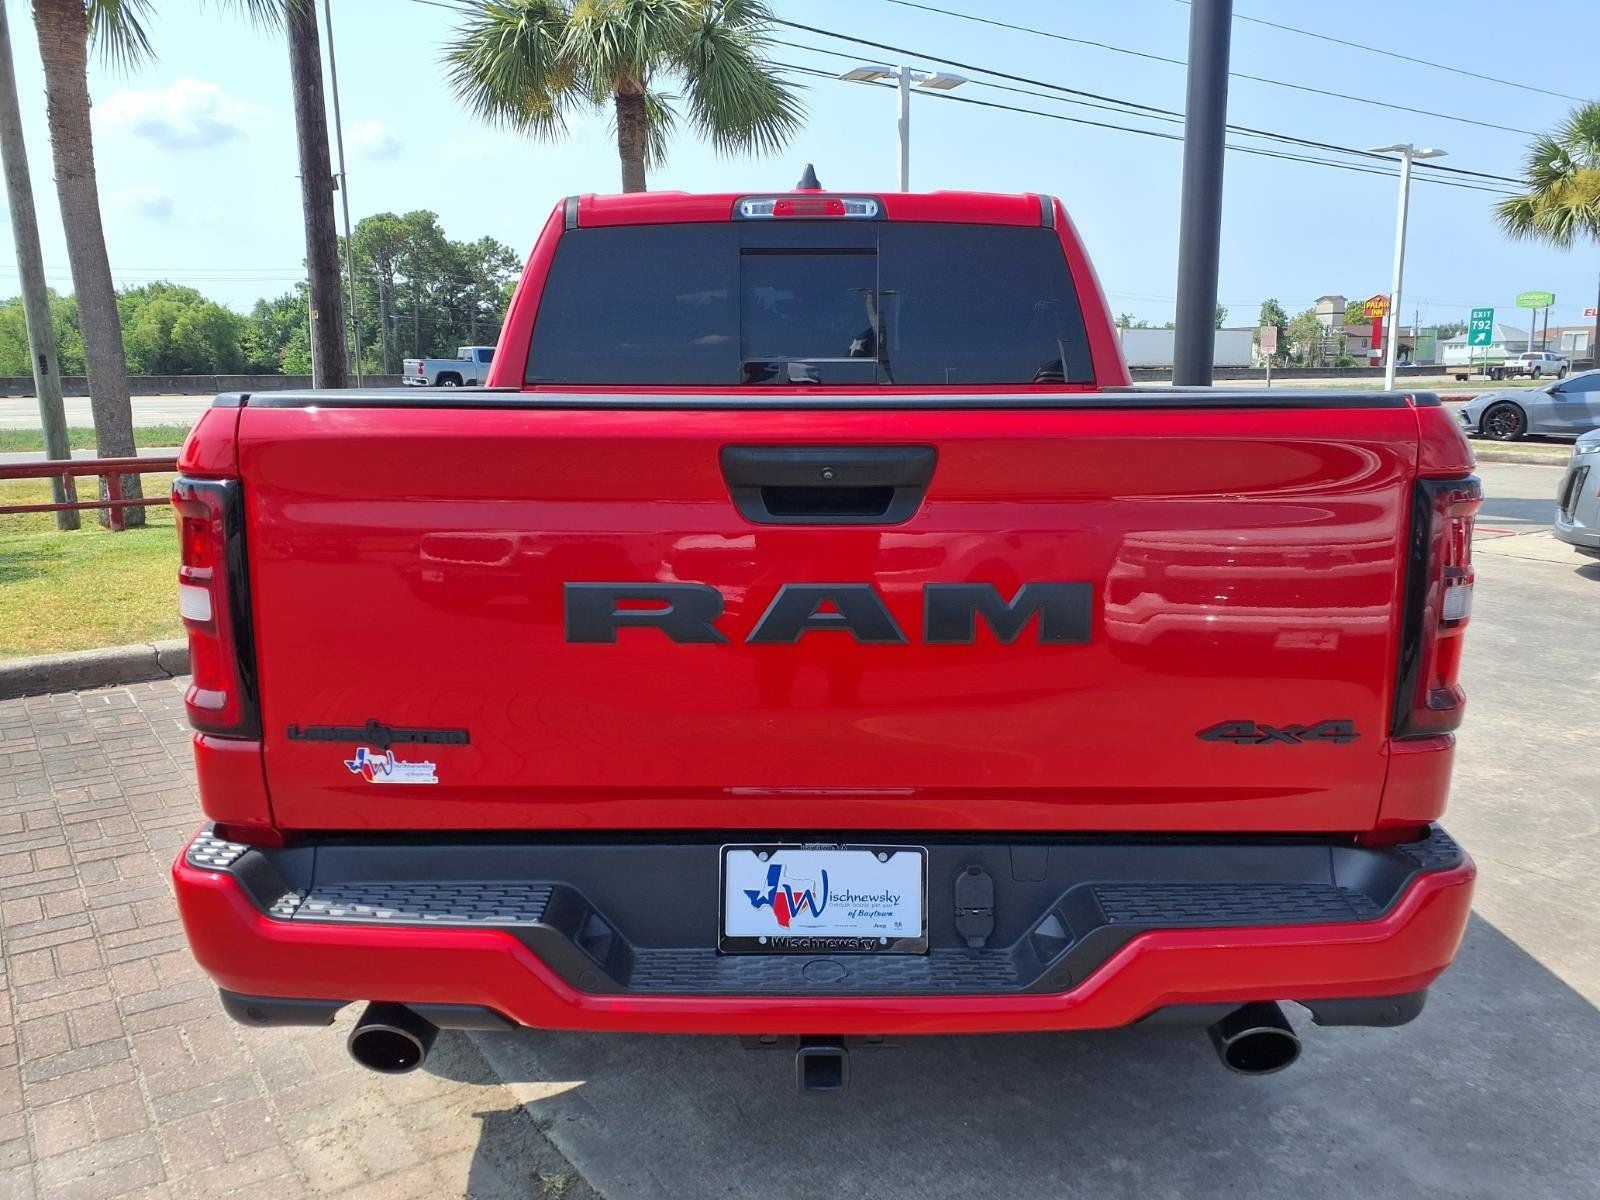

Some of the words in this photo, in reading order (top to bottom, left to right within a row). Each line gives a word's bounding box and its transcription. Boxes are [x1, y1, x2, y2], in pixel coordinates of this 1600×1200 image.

[1472, 310, 1492, 319] EXIT
[1471, 320, 1491, 330] 792
[563, 581, 1094, 645] RAM
[1195, 720, 1361, 745] 4x4
[771, 936, 876, 950] Wischnewsky
